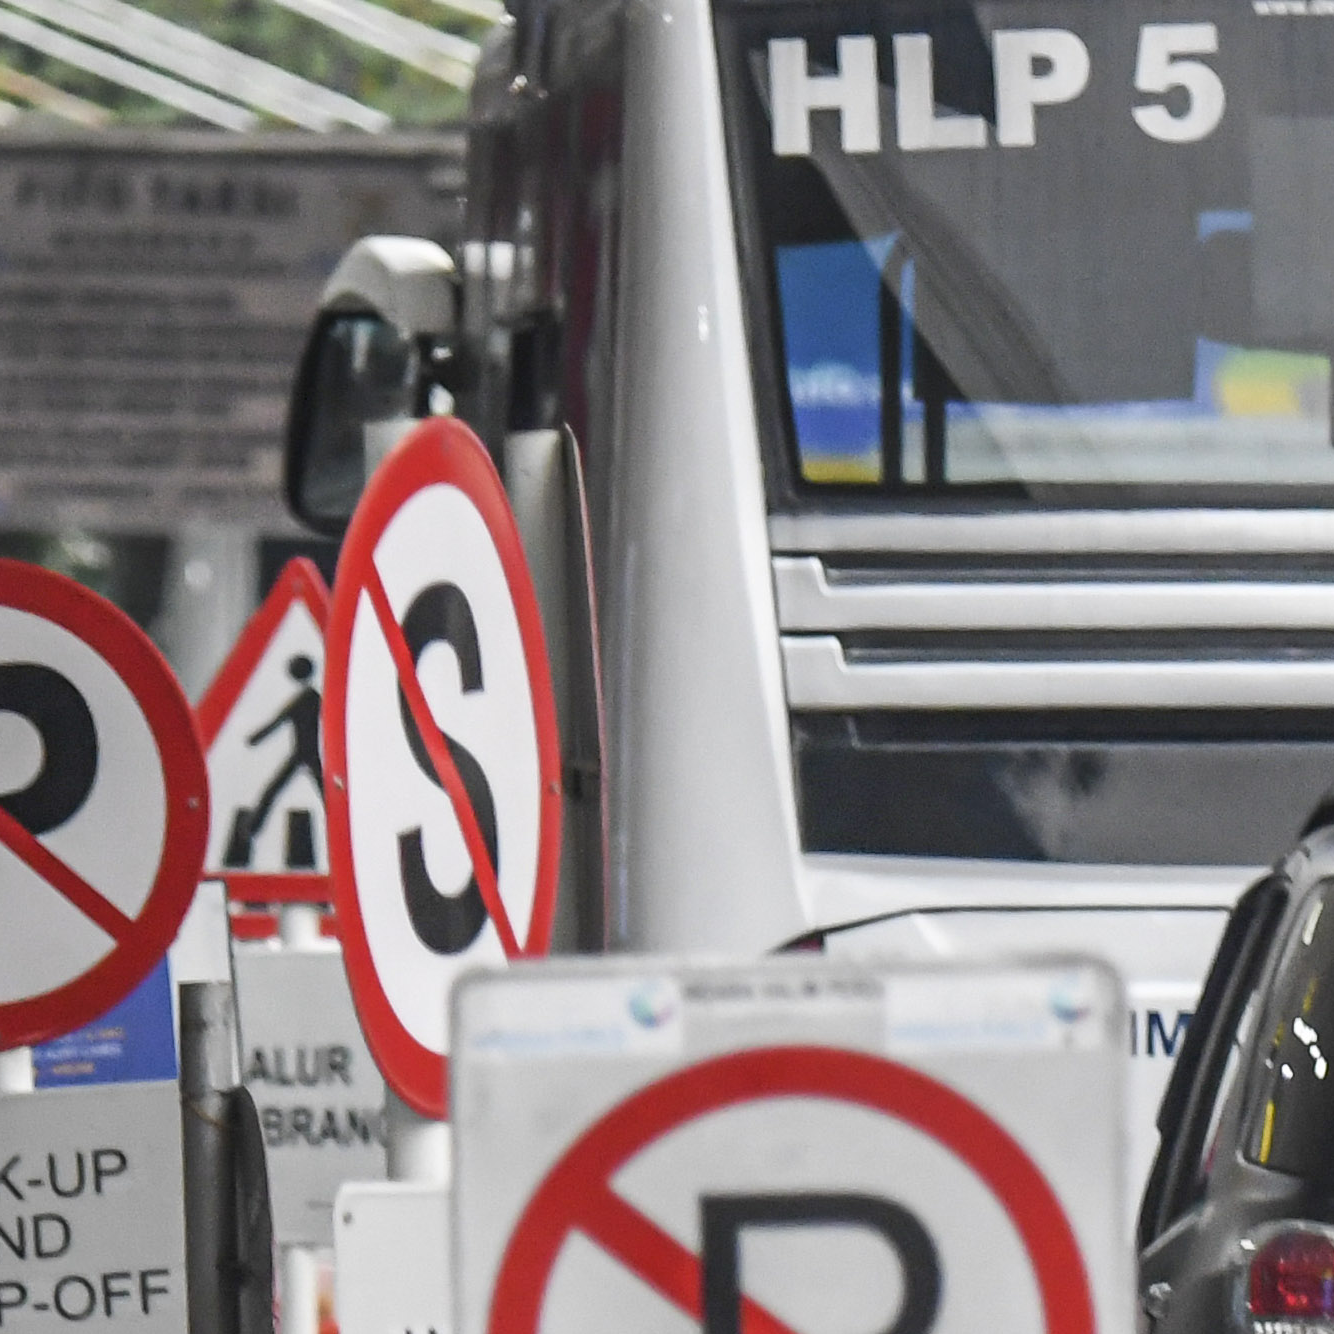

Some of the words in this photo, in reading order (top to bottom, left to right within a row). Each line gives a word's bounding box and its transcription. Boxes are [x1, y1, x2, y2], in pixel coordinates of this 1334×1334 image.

[767, 28, 1091, 156] HLP
[1130, 22, 1227, 144] 5
[396, 580, 500, 956] S
[245, 1045, 354, 1087] ALUR
